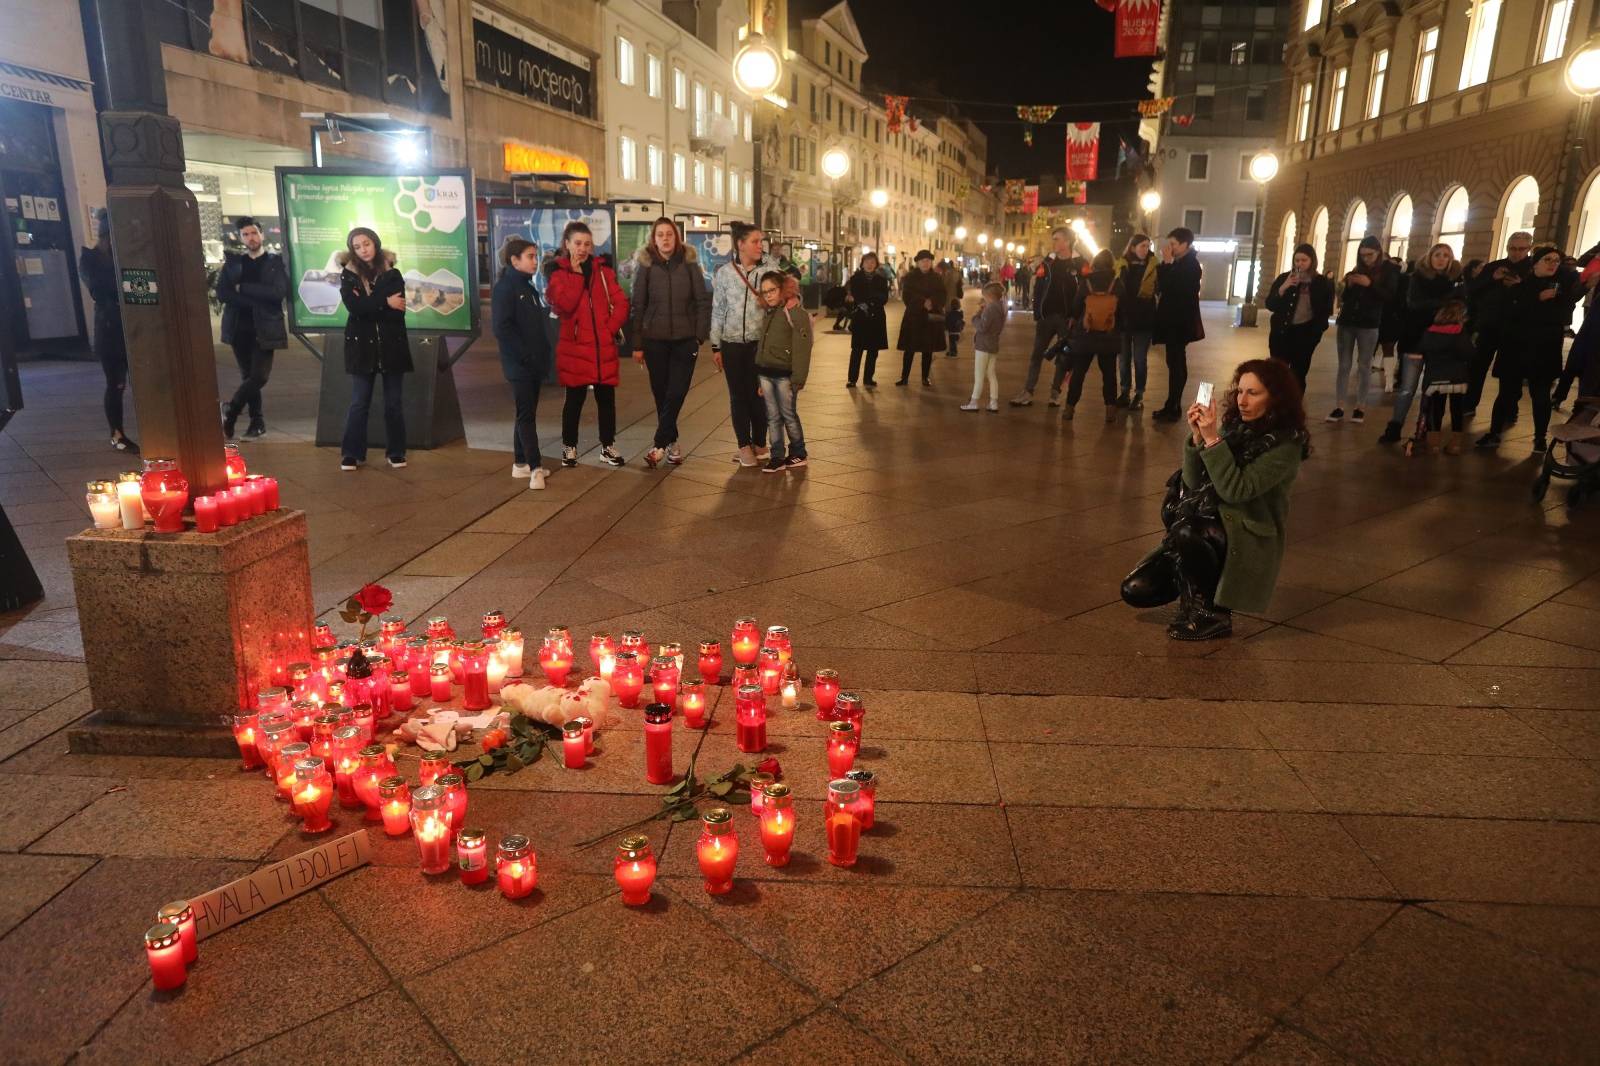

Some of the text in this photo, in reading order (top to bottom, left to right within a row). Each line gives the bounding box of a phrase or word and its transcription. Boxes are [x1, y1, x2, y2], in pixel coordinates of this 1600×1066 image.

[1, 83, 54, 104] CENTAR
[193, 878, 266, 935] HVALA
[269, 866, 294, 896] TI
